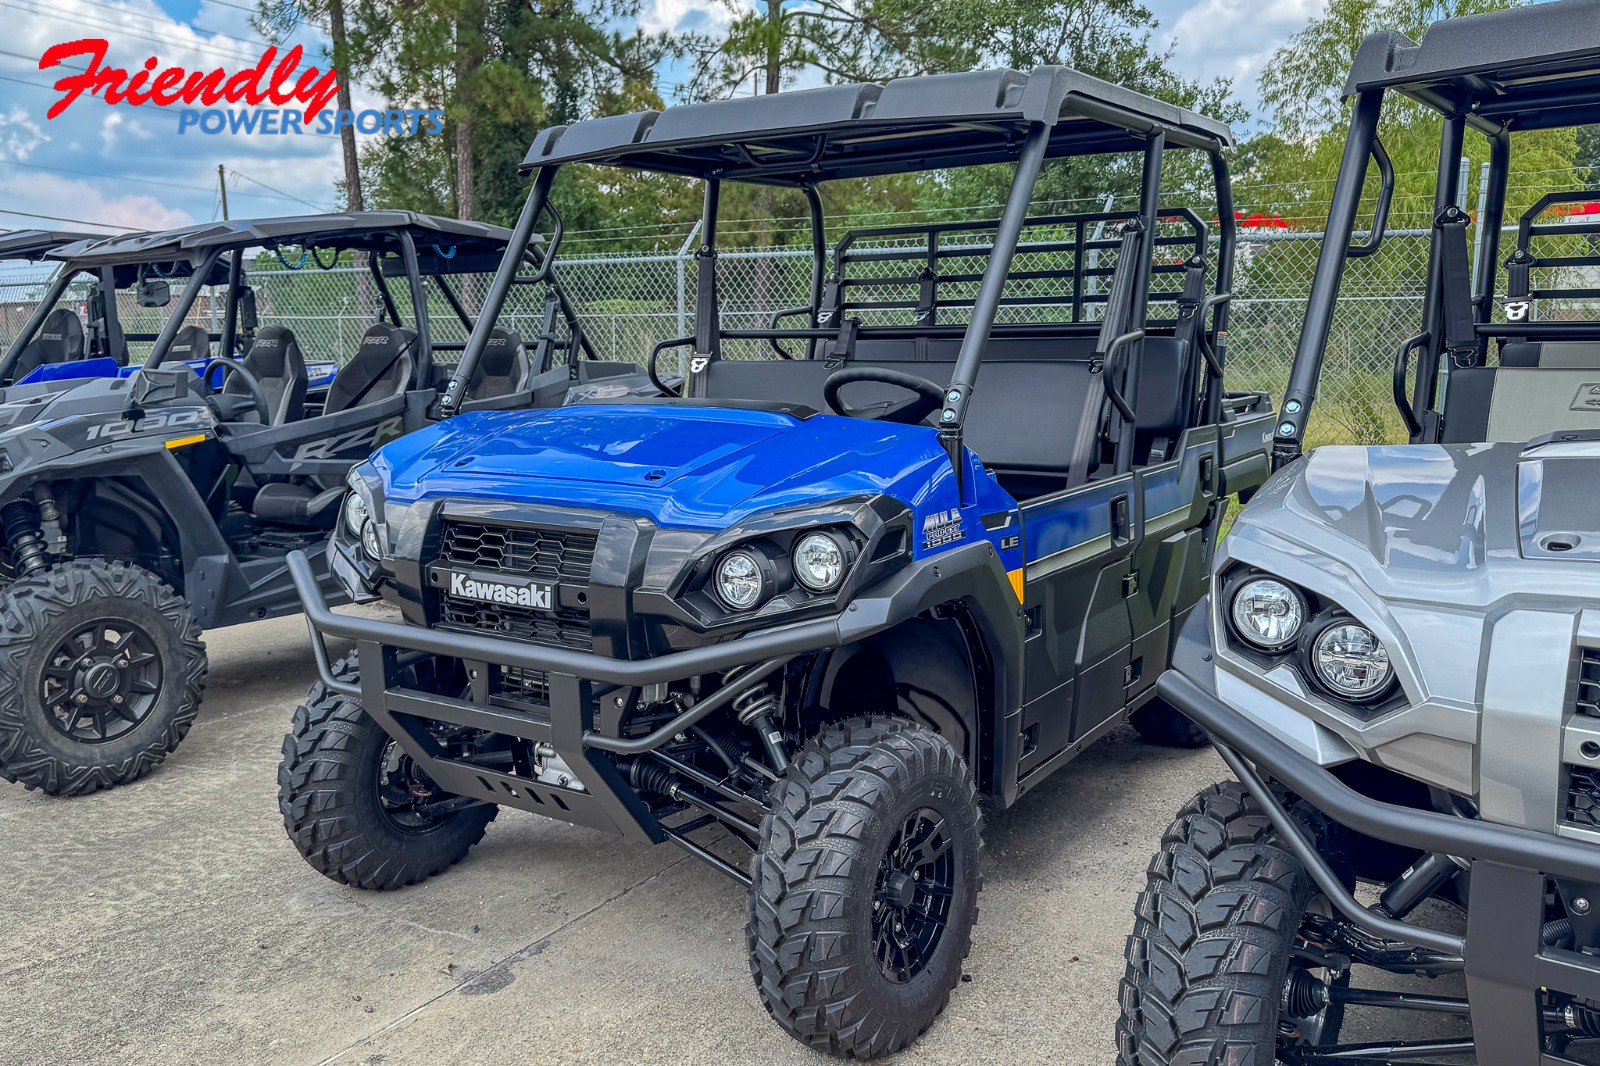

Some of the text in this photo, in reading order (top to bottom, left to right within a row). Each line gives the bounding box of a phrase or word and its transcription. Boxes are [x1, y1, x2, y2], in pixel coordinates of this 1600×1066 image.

[363, 336, 389, 345] RZR
[486, 338, 507, 346] ZR
[289, 415, 403, 472] RZR
[922, 507, 963, 534] MULE
[1001, 536, 1019, 550] LE
[450, 572, 552, 610] Kawasaki
